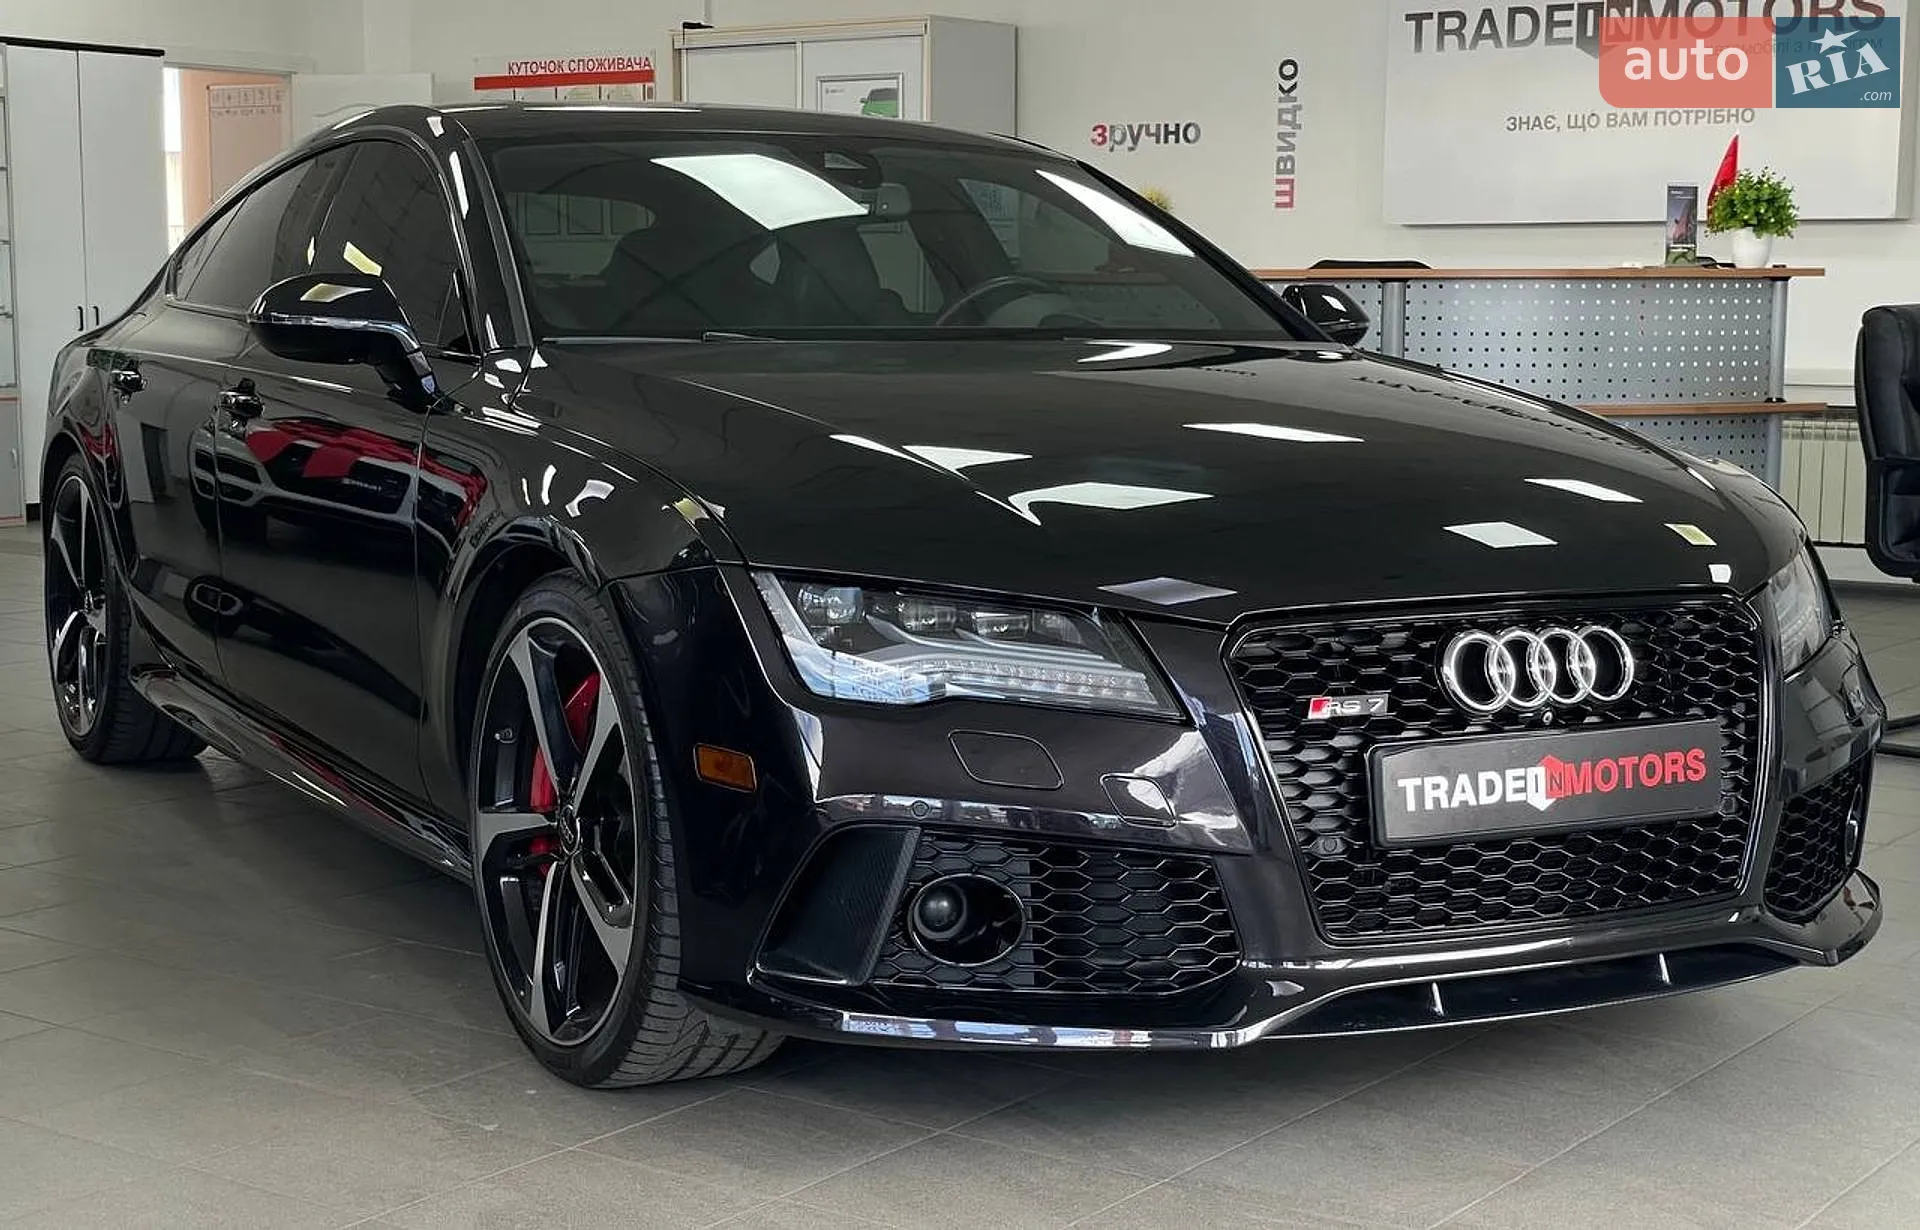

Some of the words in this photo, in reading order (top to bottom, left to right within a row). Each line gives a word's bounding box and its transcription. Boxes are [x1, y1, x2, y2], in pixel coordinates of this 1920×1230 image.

[508, 60, 564, 76] КУТОЧОК
[568, 56, 653, 73] СПОЖИВАЧА
[1275, 58, 1303, 209] швидко
[1505, 114, 1562, 133] ЗНАЄ,
[1566, 112, 1601, 132] ЩО
[1605, 110, 1649, 129] ВАМ
[1653, 107, 1757, 128] ПОТРІБНО
[1090, 122, 1201, 153] зручно
